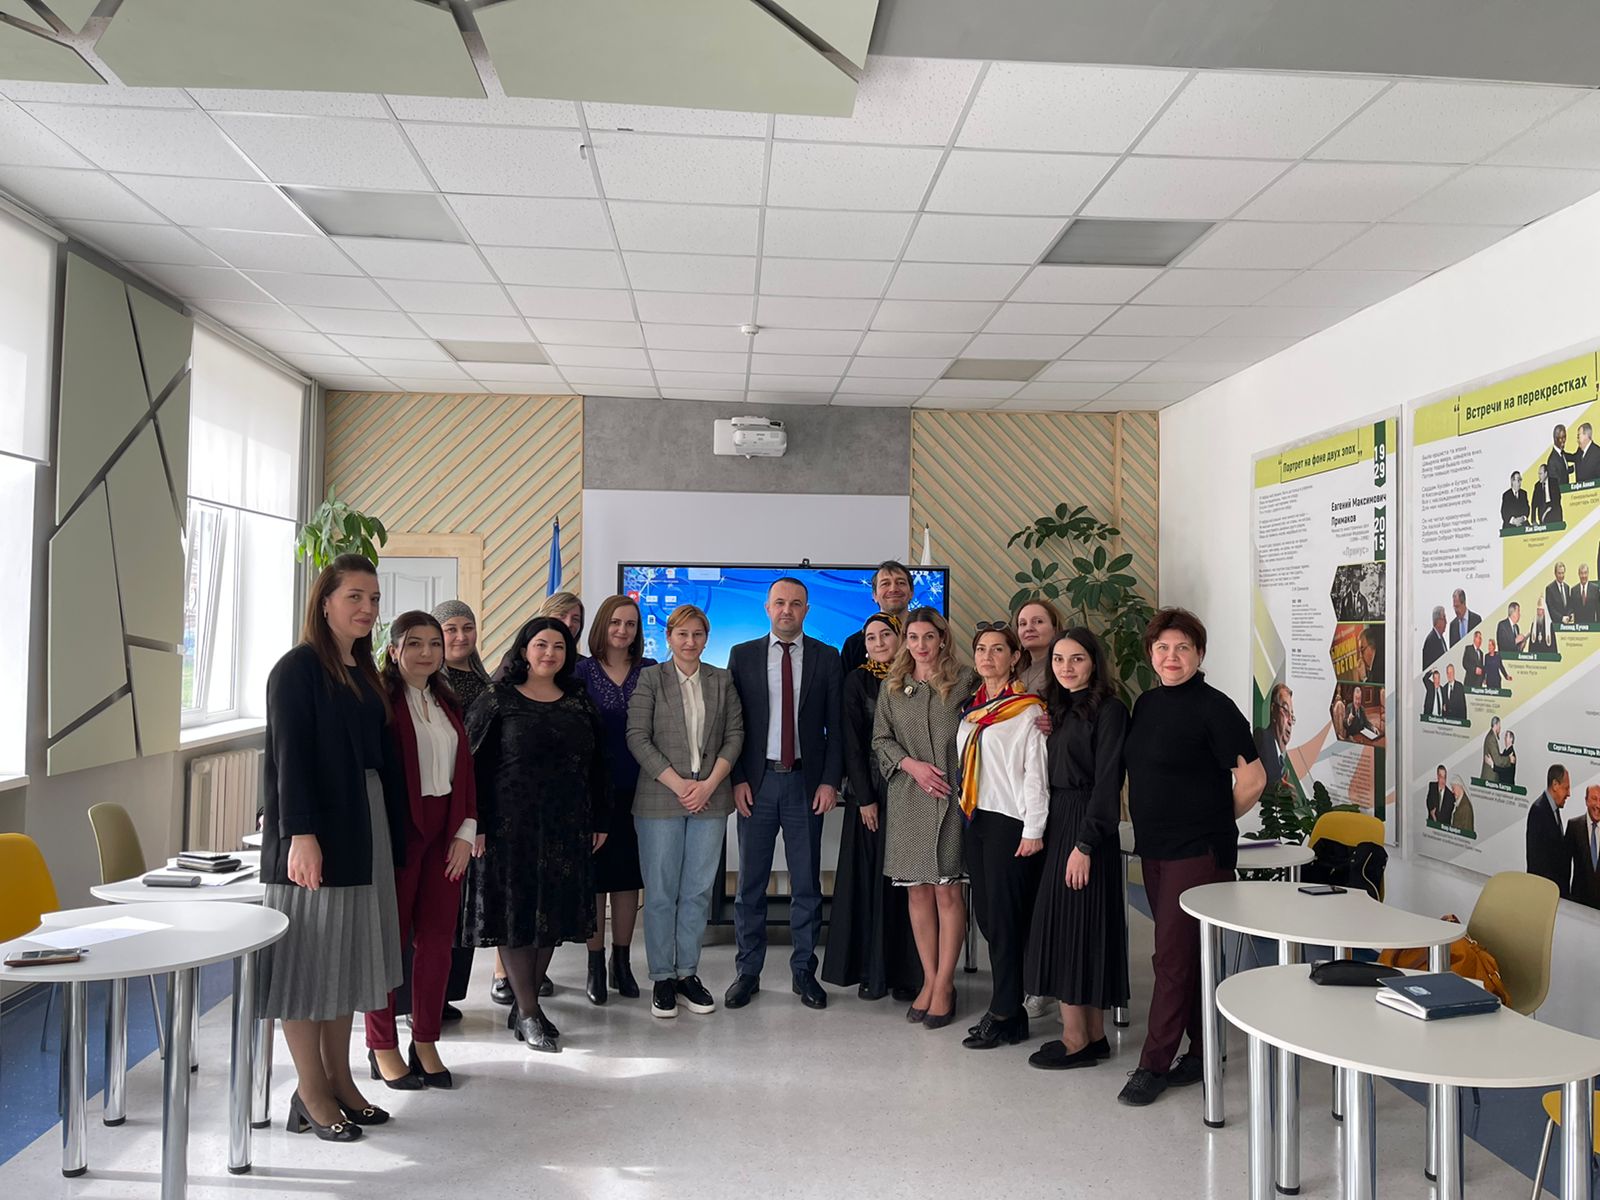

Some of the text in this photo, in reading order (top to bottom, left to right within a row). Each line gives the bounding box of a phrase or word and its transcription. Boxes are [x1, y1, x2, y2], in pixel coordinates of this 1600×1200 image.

[1466, 376, 1587, 420] Встречи на перекрестках
[1283, 445, 1356, 473] Портрет на фоне двух эпох
[1374, 443, 1385, 461] 19
[1374, 463, 1385, 479] 29
[1331, 493, 1387, 512] Евгений Максимович
[1331, 514, 1357, 527] Примаков
[1374, 516, 1385, 533] 20
[1374, 534, 1385, 551] 15
